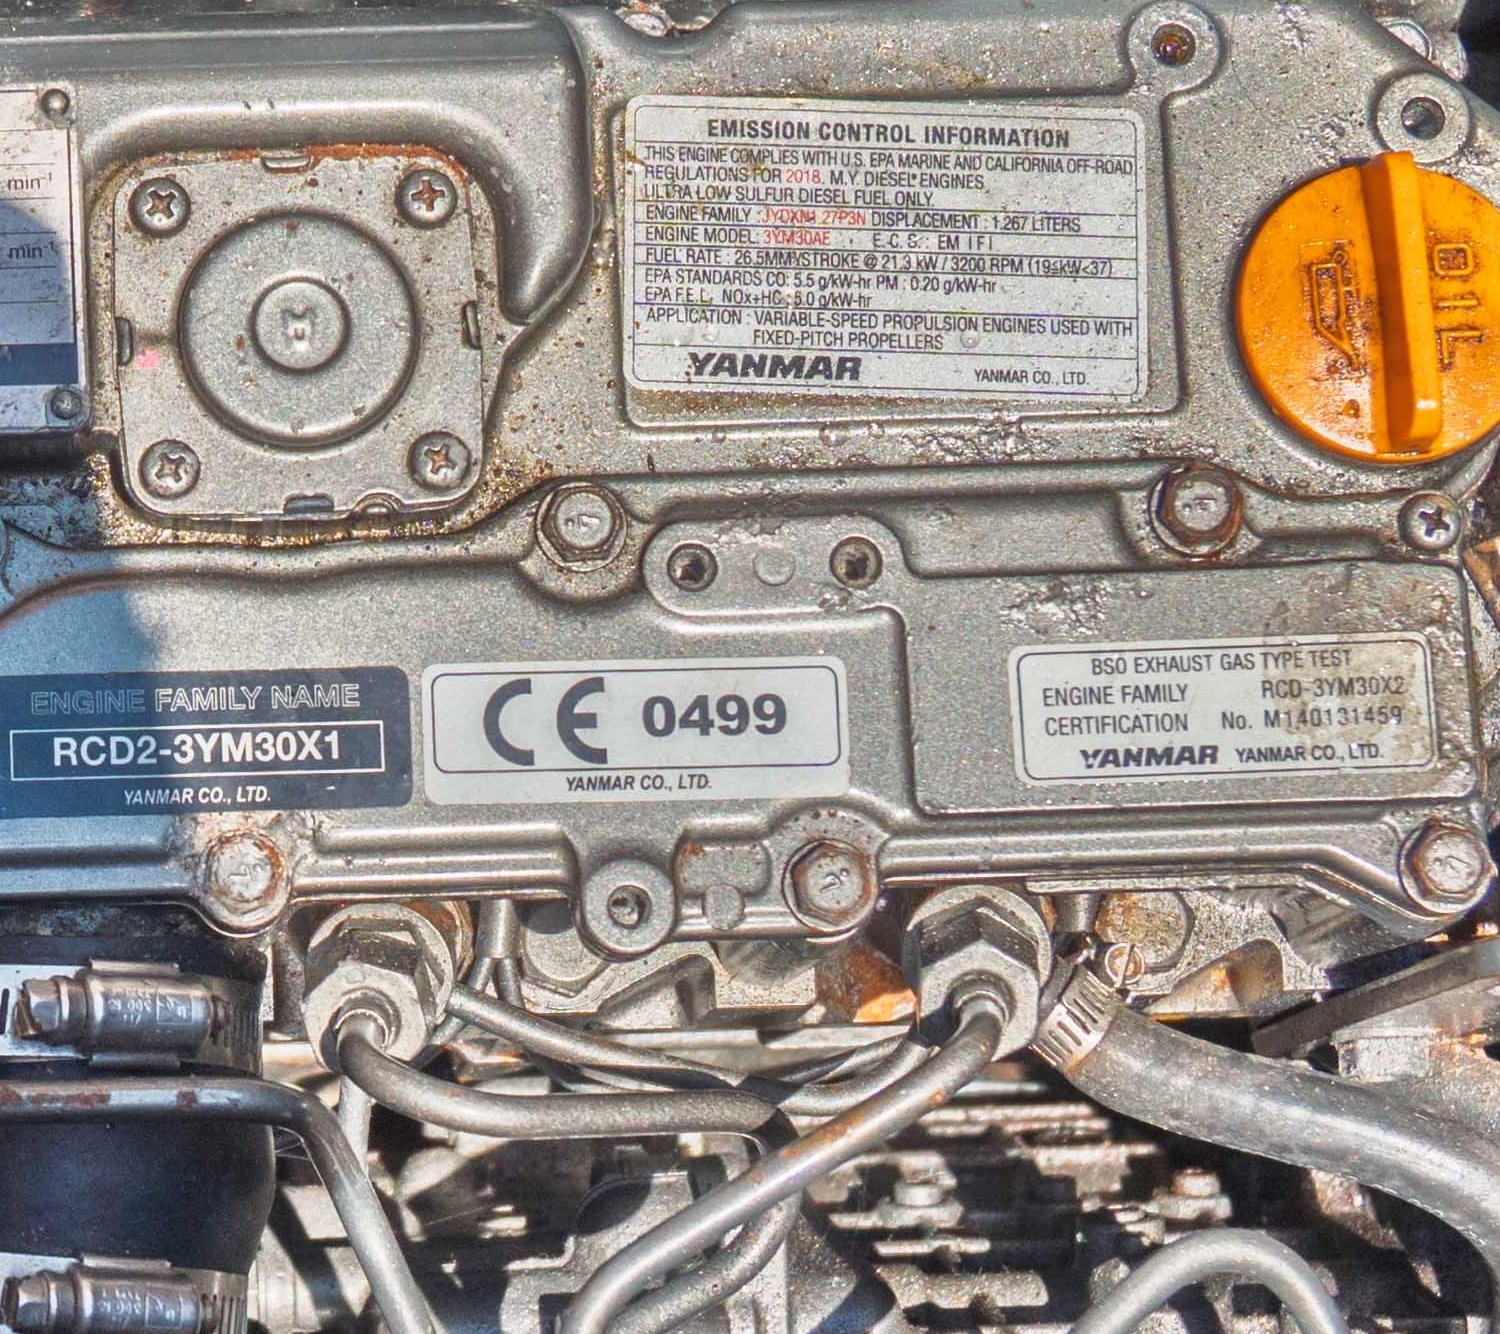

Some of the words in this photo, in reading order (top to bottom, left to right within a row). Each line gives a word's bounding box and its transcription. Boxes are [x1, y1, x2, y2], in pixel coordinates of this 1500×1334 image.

[708, 119, 810, 140] EMISSION
[818, 123, 915, 143] CONTROL
[925, 125, 1069, 148] INFORMATION
[644, 145, 675, 161] THIS
[679, 147, 727, 163] ENGINE
[730, 148, 799, 165] COMPLIES
[803, 150, 837, 166] WITH
[841, 152, 866, 167] U.S.
[870, 152, 894, 168] EPA
[899, 153, 950, 170] MARINE
[954, 155, 982, 171] AND
[985, 156, 1064, 173] CALIFORNIA
[1067, 158, 1133, 175] OFF-ROAD
[644, 166, 750, 183] REGULATIONS
[753, 167, 782, 183] FOR
[830, 170, 860, 186] M.Y.
[864, 171, 914, 188] DIESEL
[919, 172, 984, 190] ENGINES
[644, 183, 692, 200] ULTRA
[696, 185, 732, 201] LOW
[735, 187, 794, 202] SULFUR
[799, 188, 849, 204] DIESEL
[854, 189, 891, 206] FUEL
[645, 206, 700, 220] ENGINE
[702, 207, 752, 222] FAMILY
[872, 210, 980, 229] DISPLACEMENT
[1032, 217, 1081, 232] LITERS
[645, 226, 699, 243] ENGINE
[764, 230, 830, 246] 3YM30AE
[938, 235, 960, 250] EM
[645, 247, 681, 263] FUEL
[686, 249, 721, 264] RATE
[863, 254, 878, 270] @
[882, 255, 911, 271] 21.3
[916, 257, 938, 271] kW
[951, 257, 985, 273] 3200
[990, 258, 1023, 273] RPM
[645, 268, 670, 283] EPA
[676, 269, 761, 287] STANDARDS
[794, 272, 815, 288] 5.5
[818, 274, 872, 290] g/kW-hr
[876, 275, 898, 290] PM
[910, 276, 939, 291] 0.20
[943, 278, 997, 295] g/kW-hr
[645, 287, 670, 302] EPA
[794, 291, 815, 307] 5.0
[818, 293, 872, 309] g/kW-hr
[1431, 242, 1484, 371] OIL
[646, 307, 742, 325] APPLICATION
[754, 310, 878, 329] VARIABLE-SPEED
[883, 314, 978, 332] PROPULSION
[982, 317, 1046, 334] ENGINES
[1050, 319, 1090, 336] USED
[1094, 321, 1133, 337] WITH
[754, 329, 843, 347] FIXED-PITCH
[849, 332, 944, 350] PROPELLERS
[688, 352, 862, 381] YANMAR
[974, 368, 1028, 384] YANMAR
[1032, 369, 1059, 386] CO.,
[1062, 371, 1090, 386] LTD.
[1091, 658, 1127, 676] BSO
[1134, 654, 1213, 674] EXHAUST
[1219, 652, 1256, 671] GAS
[1261, 650, 1304, 670] TYPE
[1309, 649, 1352, 668] TEST
[30, 689, 147, 716] ENGINE
[155, 686, 262, 712] FAMILY
[271, 683, 361, 709] NAME
[1042, 686, 1114, 707] ENGINE
[1121, 683, 1188, 704] FAMILY
[1261, 675, 1406, 699] RCD-3YM30X2
[483, 676, 608, 766] CE
[642, 693, 787, 738] 0499
[1044, 713, 1189, 736] CERTIFICATION
[1221, 711, 1253, 731] No.
[53, 730, 341, 767] RCD2-3YM30X1
[1080, 744, 1219, 768] YANMAR
[1235, 746, 1306, 762] YANMAR
[1311, 744, 1345, 762] CO.,
[1349, 743, 1384, 759] LTD.
[123, 787, 193, 806] YANMAR
[198, 786, 232, 805] CO.,
[236, 785, 271, 803] LTD.
[566, 775, 635, 792] YANMAR
[639, 774, 673, 792] CO.,
[677, 773, 712, 790] LTD.
